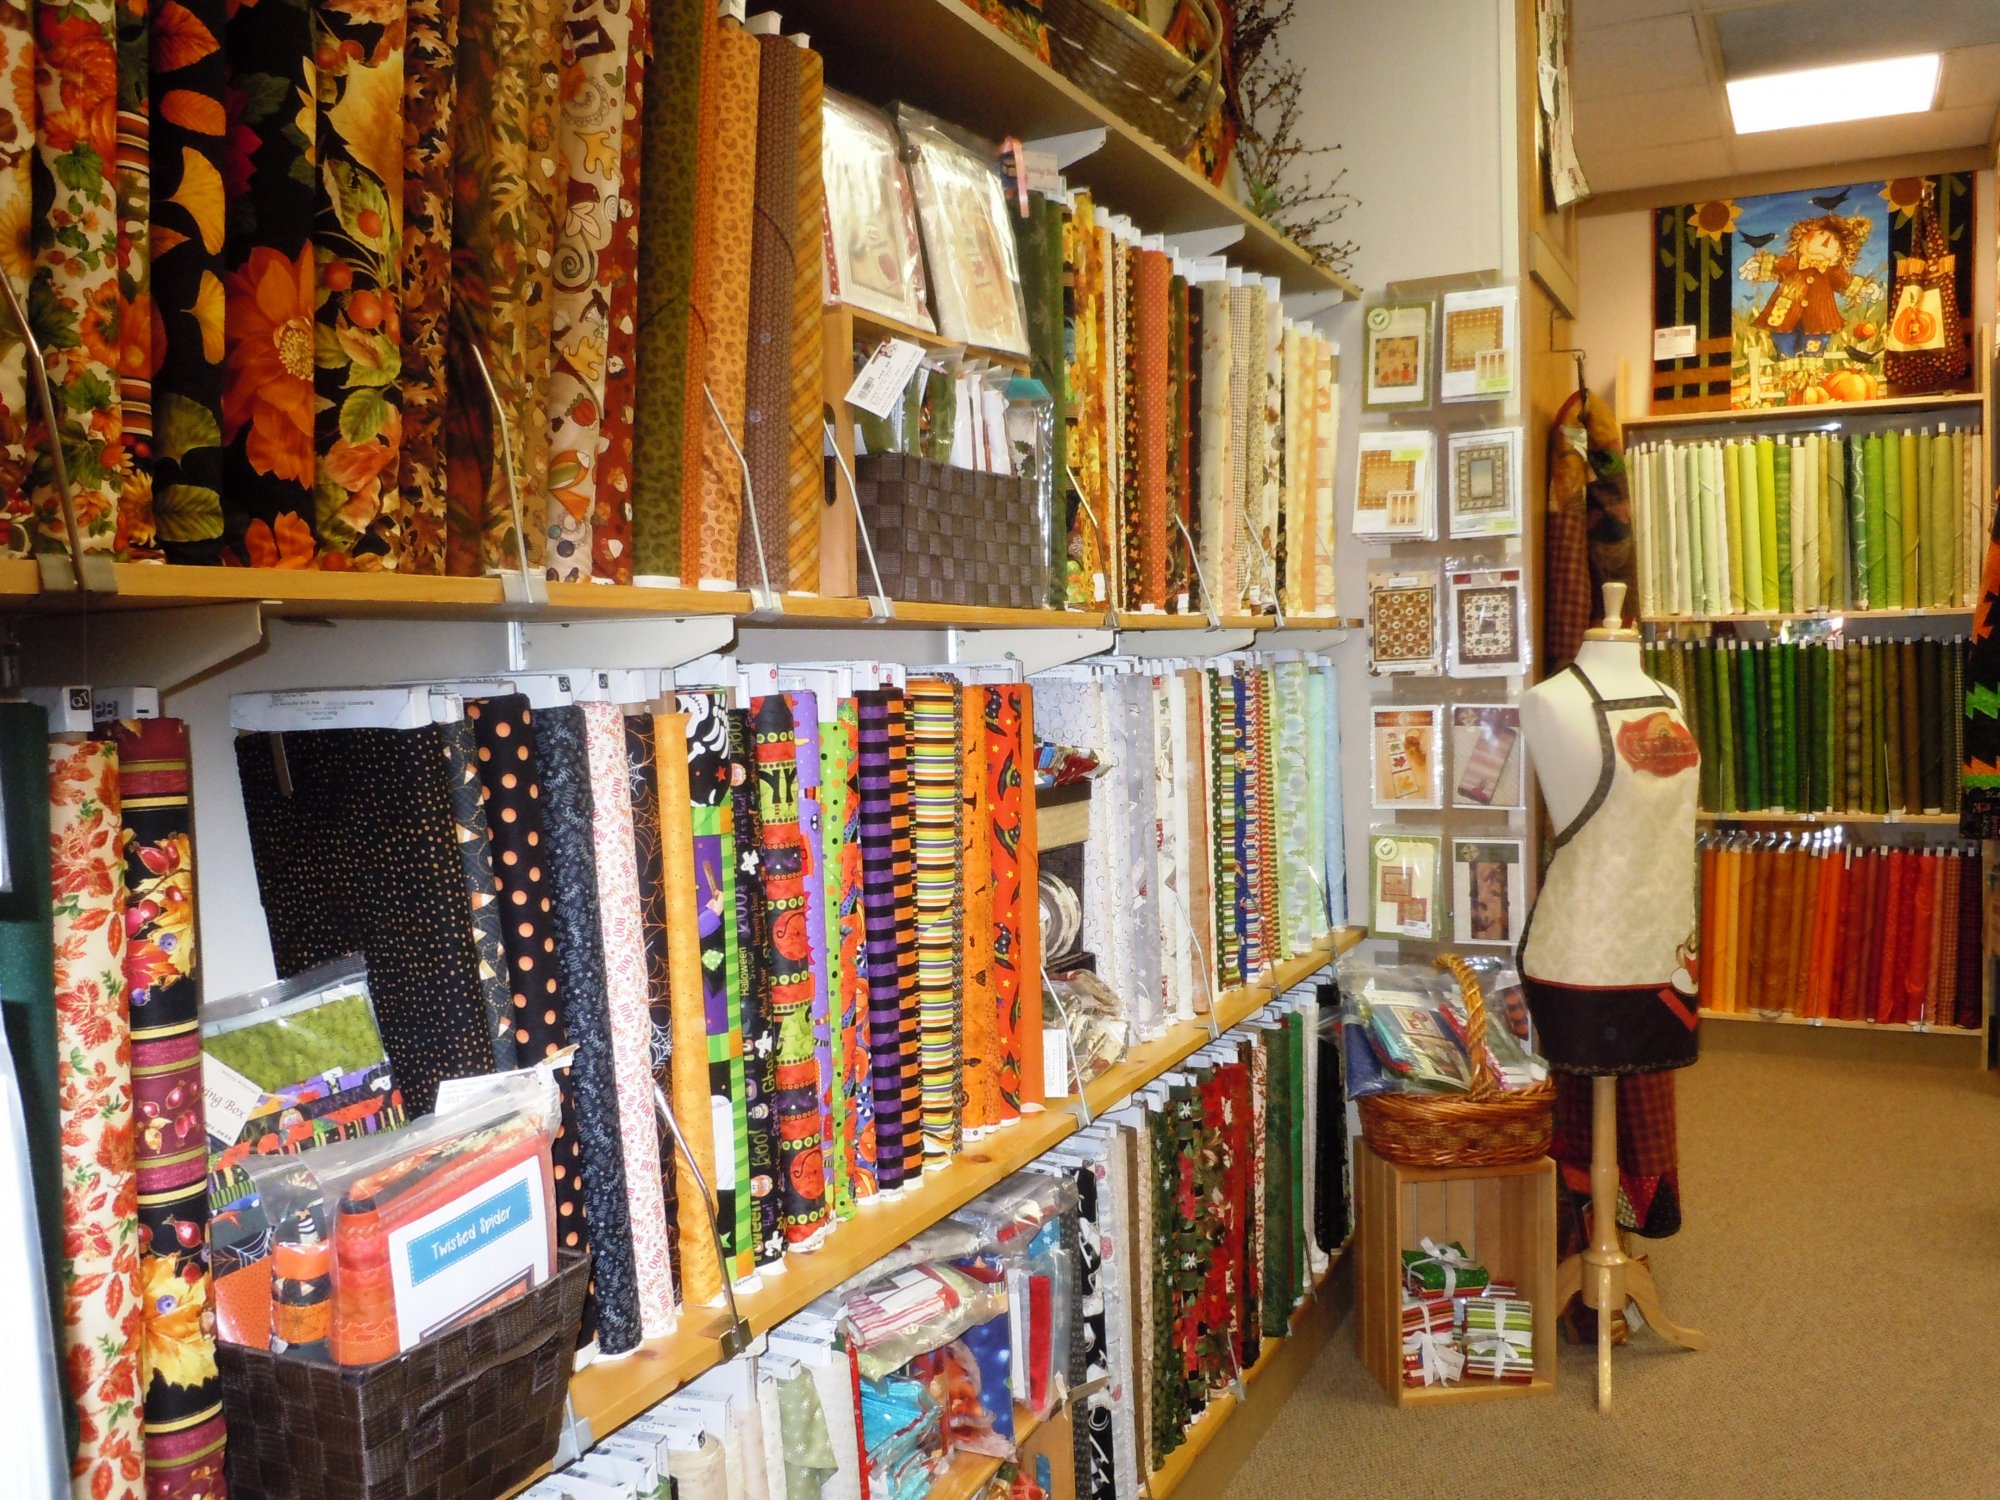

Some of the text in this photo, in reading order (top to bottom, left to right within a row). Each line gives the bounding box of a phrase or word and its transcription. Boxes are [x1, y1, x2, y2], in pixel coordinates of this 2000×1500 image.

[71, 691, 89, 708] QT
[544, 767, 575, 792] Spooky
[610, 777, 623, 798] BOO
[562, 806, 587, 833] Spooky
[620, 861, 631, 878] BOO
[560, 882, 585, 904] Spooky
[556, 902, 578, 921] BOO
[567, 921, 583, 947] Spooky
[613, 917, 626, 938] BOO
[565, 950, 582, 972] BOO
[616, 954, 634, 975] BOO
[739, 947, 750, 996] Halloween
[580, 979, 599, 995] BOO
[757, 966, 768, 993] Your
[618, 1002, 635, 1024] BOO
[578, 1076, 599, 1099] Spooky
[224, 1099, 245, 1119] Box
[637, 1098, 653, 1118] BOO
[592, 1122, 613, 1153] Spooky
[622, 1124, 637, 1139] BOO
[640, 1160, 657, 1173] BOO
[596, 1201, 610, 1219] BOO
[651, 1200, 663, 1221] BOO
[431, 1206, 511, 1260] Twisted Spider
[616, 1239, 630, 1261] BOO
[648, 1248, 664, 1270] BOO
[595, 1258, 614, 1273] BOO
[617, 1288, 631, 1310] BOO
[657, 1289, 671, 1311] BOO
[602, 1304, 628, 1332] Spooky
